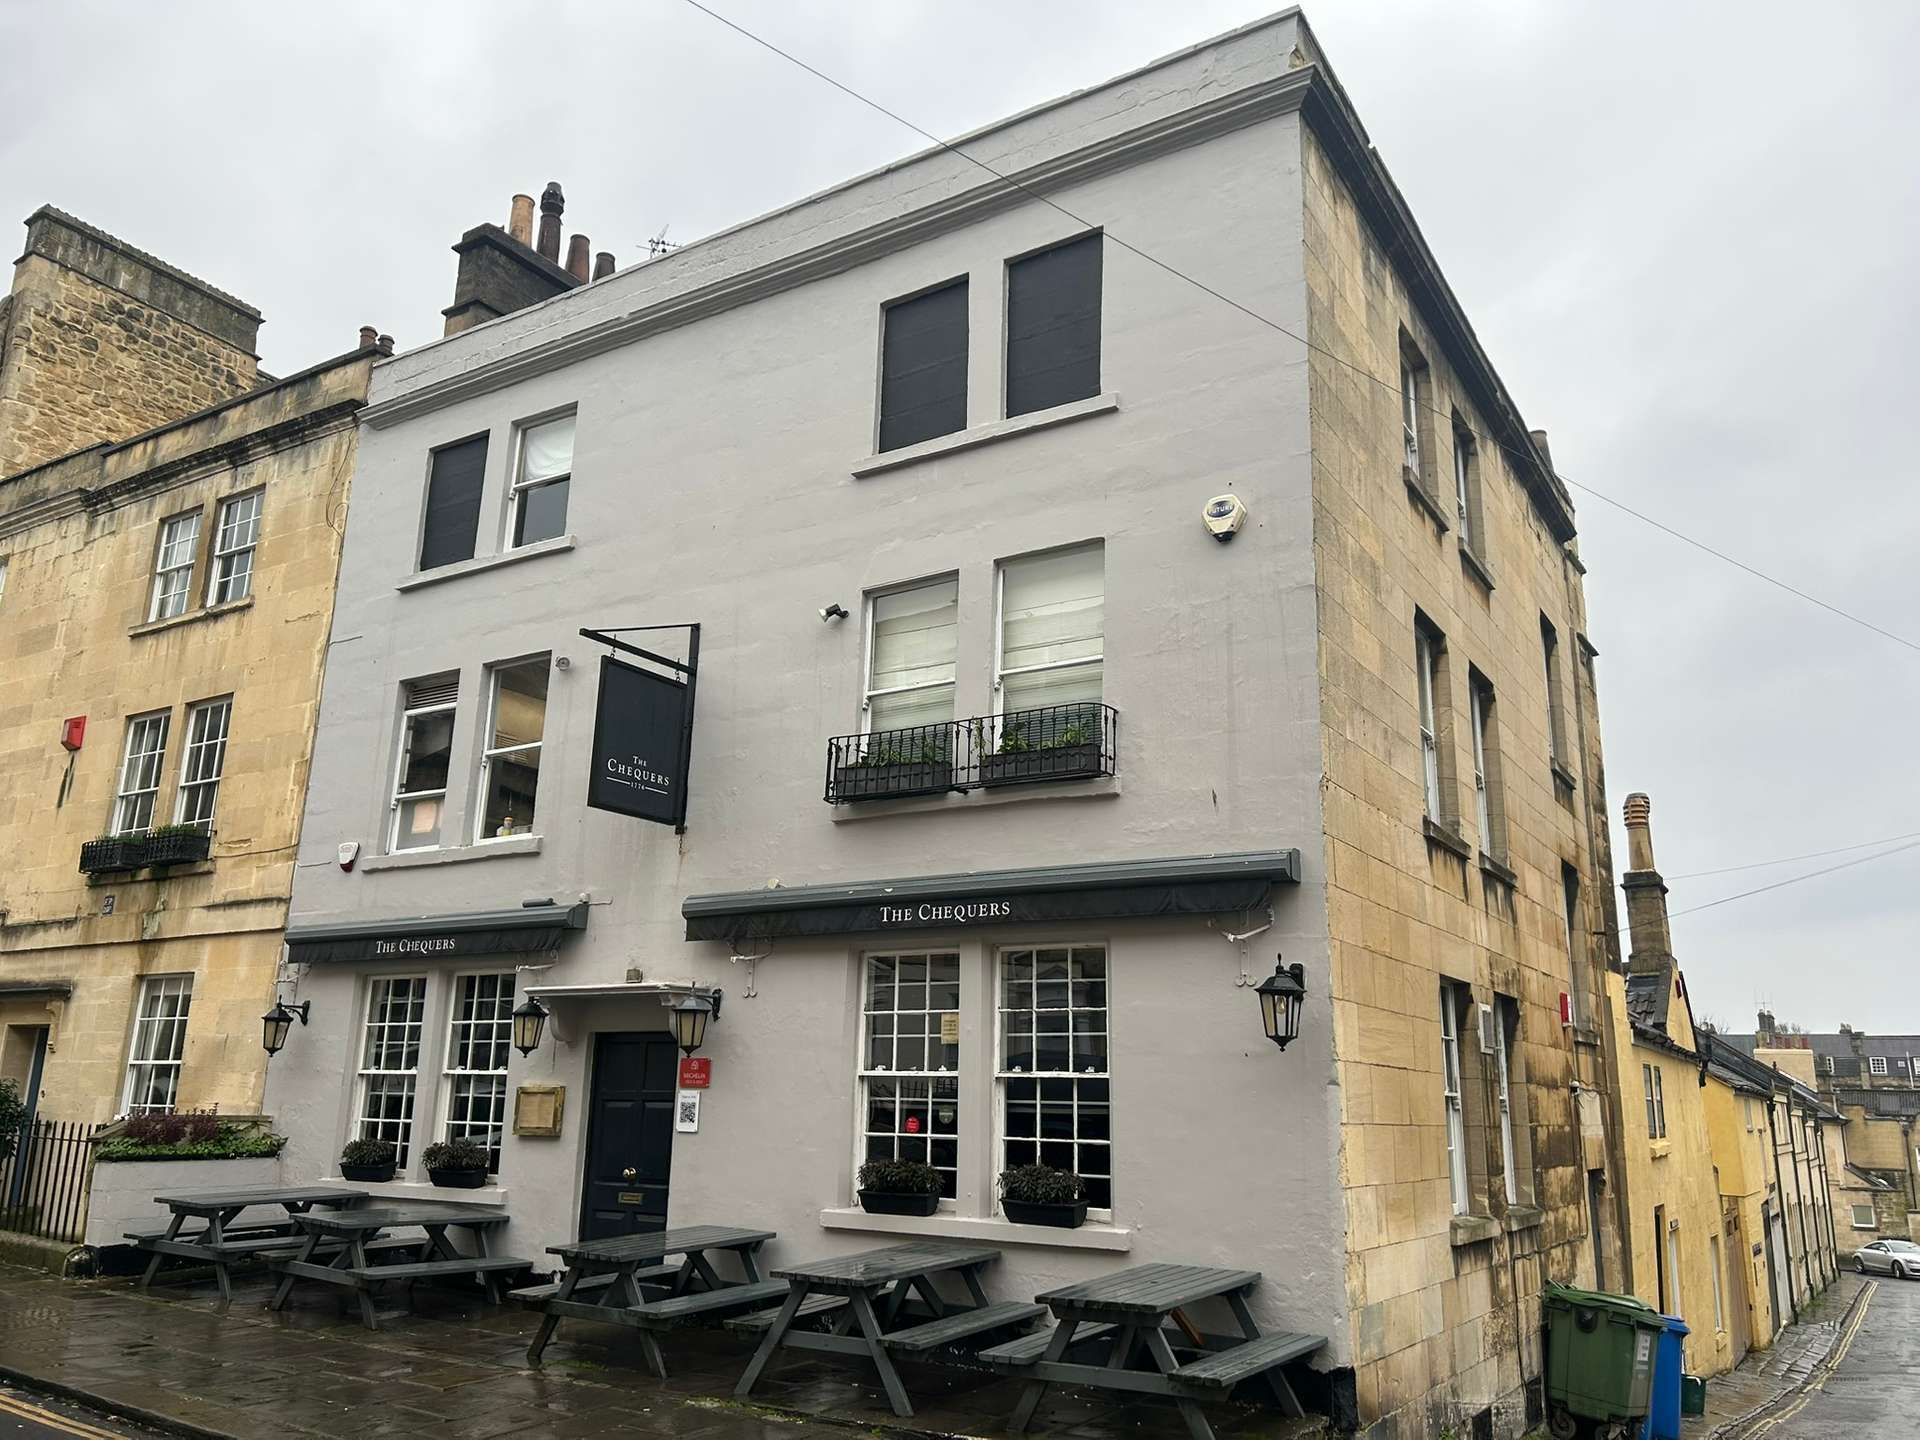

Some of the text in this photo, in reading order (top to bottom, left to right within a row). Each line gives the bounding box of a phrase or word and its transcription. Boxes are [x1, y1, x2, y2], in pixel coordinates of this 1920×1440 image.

[633, 755, 647, 766] THE
[607, 758, 669, 785] CHEQUERS
[880, 902, 1010, 922] THE CHEQUERS
[376, 938, 455, 954] THE CHEQUERS
